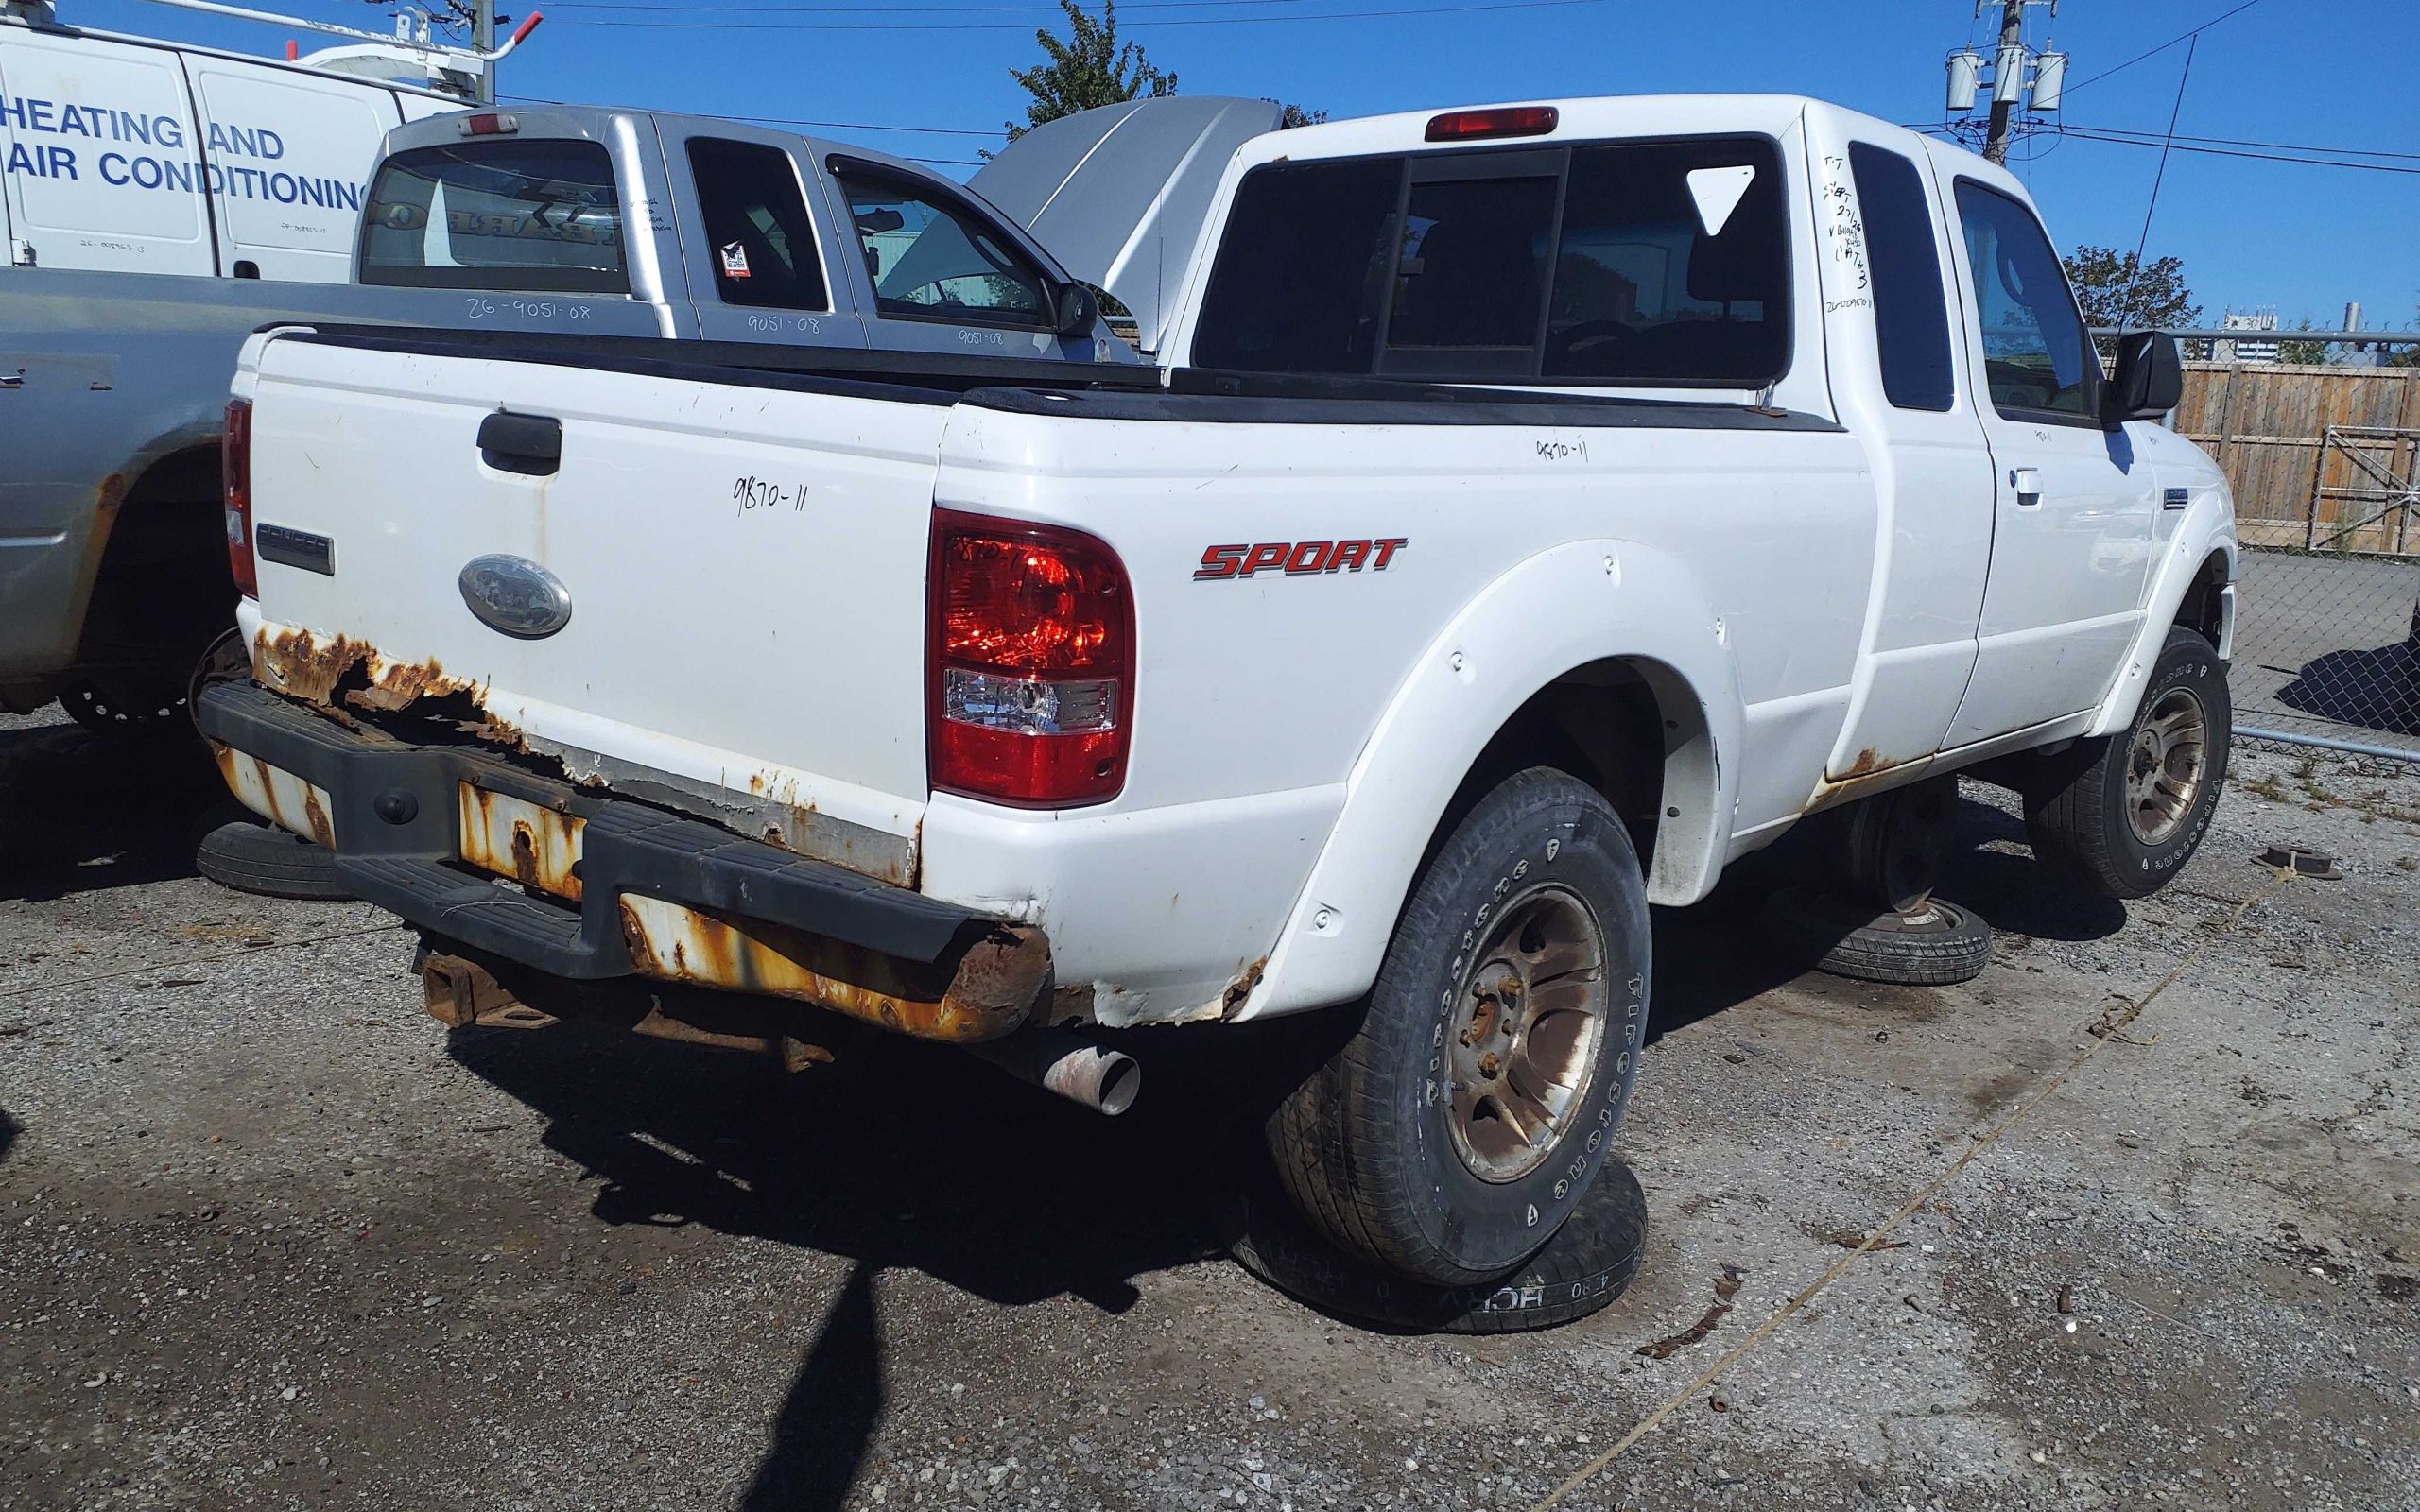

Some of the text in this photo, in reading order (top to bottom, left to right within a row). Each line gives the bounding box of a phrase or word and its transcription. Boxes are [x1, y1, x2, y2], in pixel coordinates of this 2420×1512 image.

[0, 96, 285, 160] HEATING AND
[7, 142, 79, 180] AIR
[465, 298, 591, 319] 26-9051-08
[748, 315, 820, 334] 9051-08
[959, 330, 1004, 345] 9051-08
[1536, 440, 1589, 464] 9870-11
[734, 475, 808, 518] 9870-11
[1192, 538, 1409, 581] SPORT
